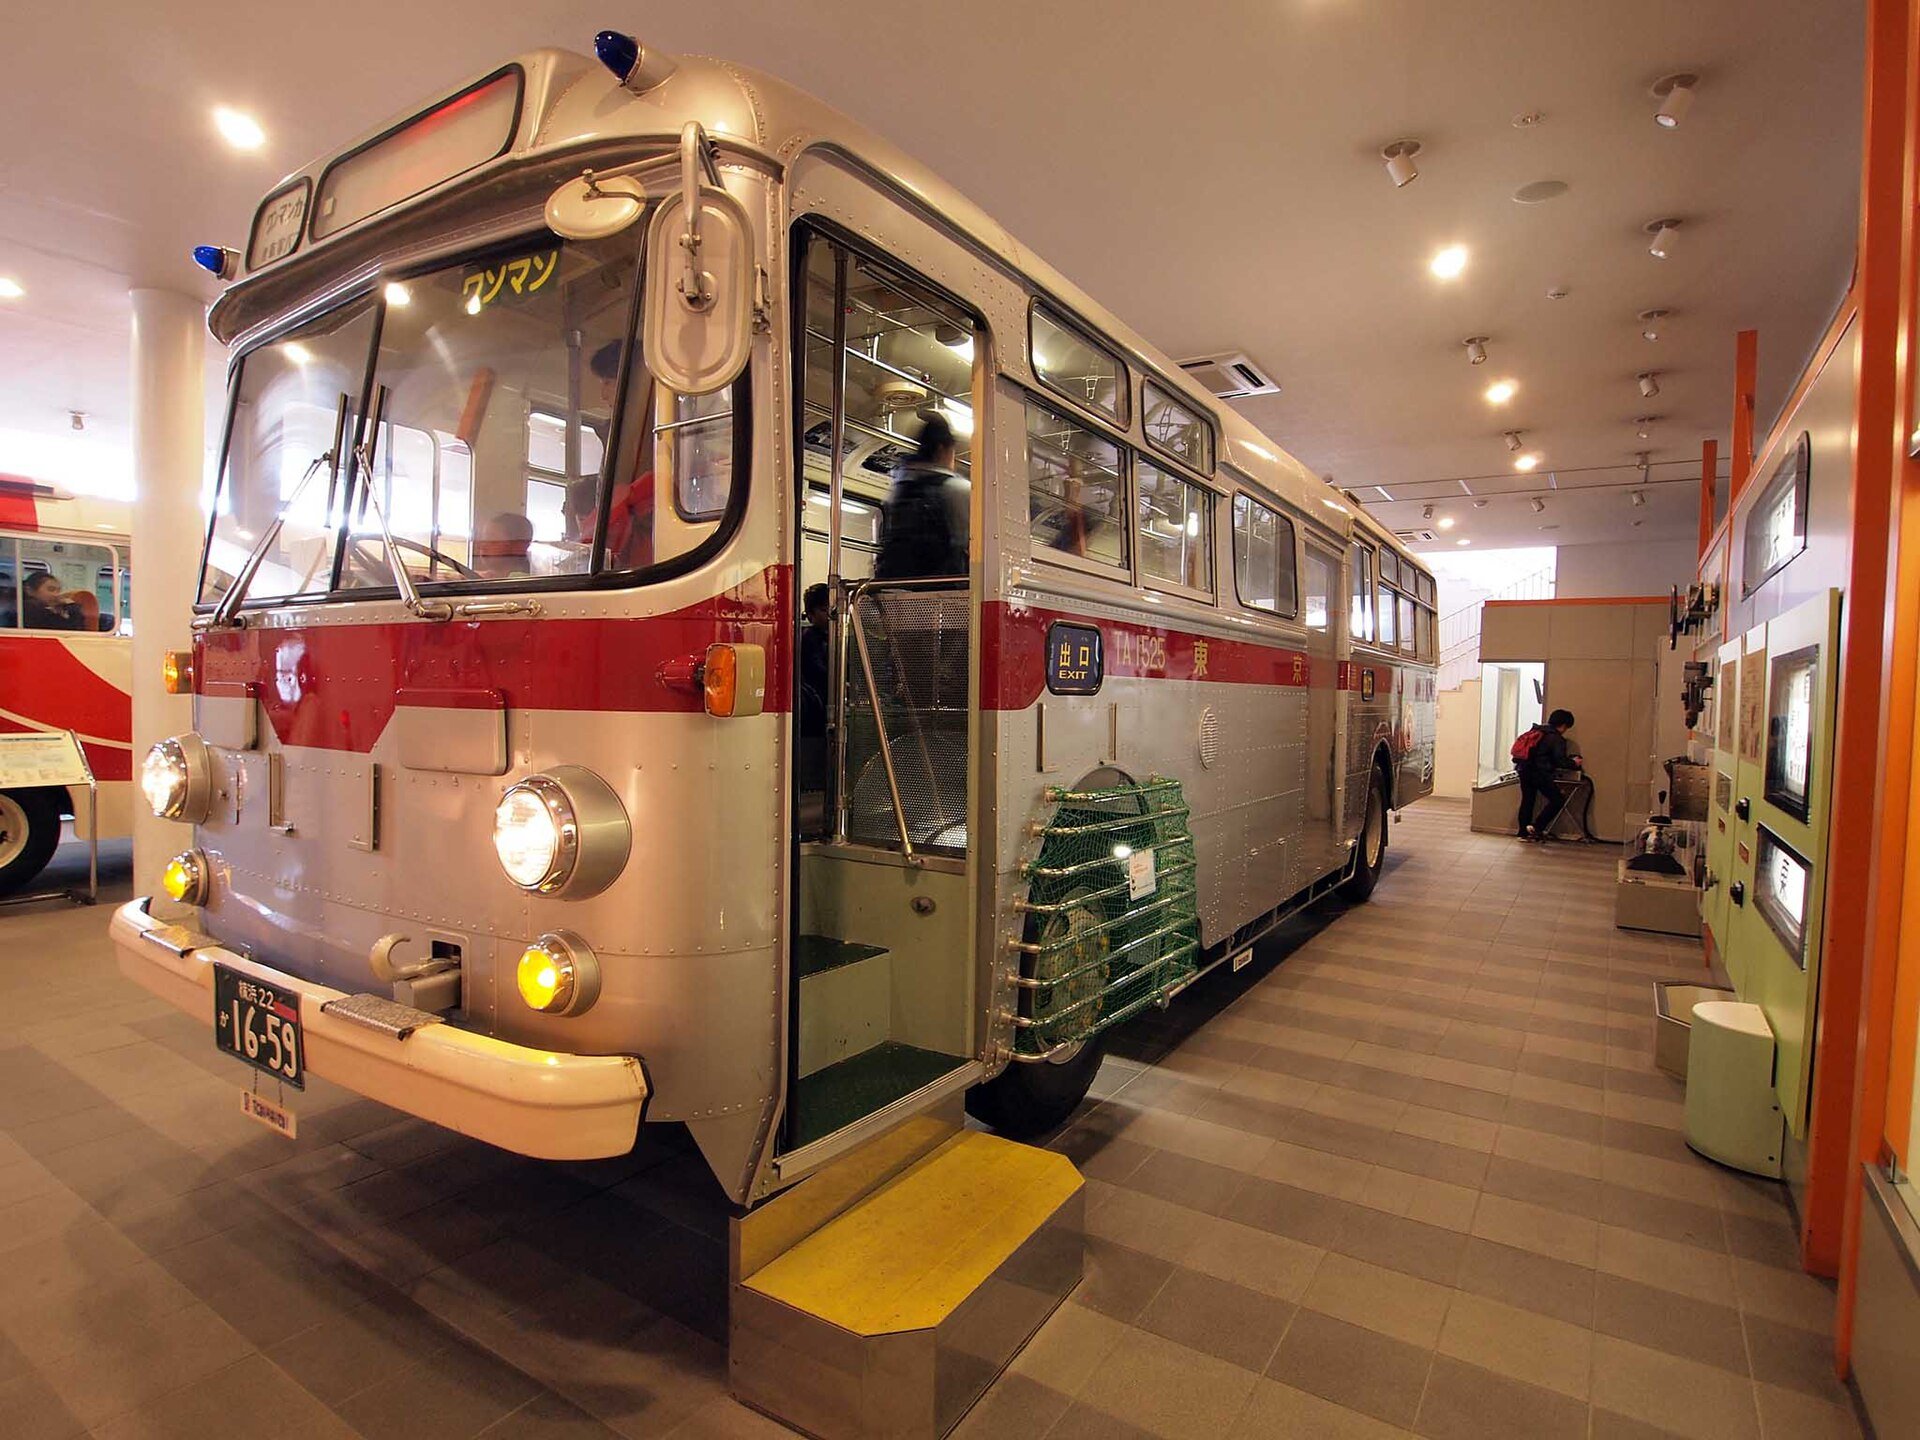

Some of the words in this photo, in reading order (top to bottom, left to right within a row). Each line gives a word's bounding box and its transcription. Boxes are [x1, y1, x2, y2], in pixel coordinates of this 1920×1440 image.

[462, 250, 558, 306] ワンマン
[1059, 642, 1091, 667] 出口
[1192, 639, 1209, 676] 東
[1058, 669, 1088, 680] EXIT
[233, 1000, 297, 1079] 16-59
